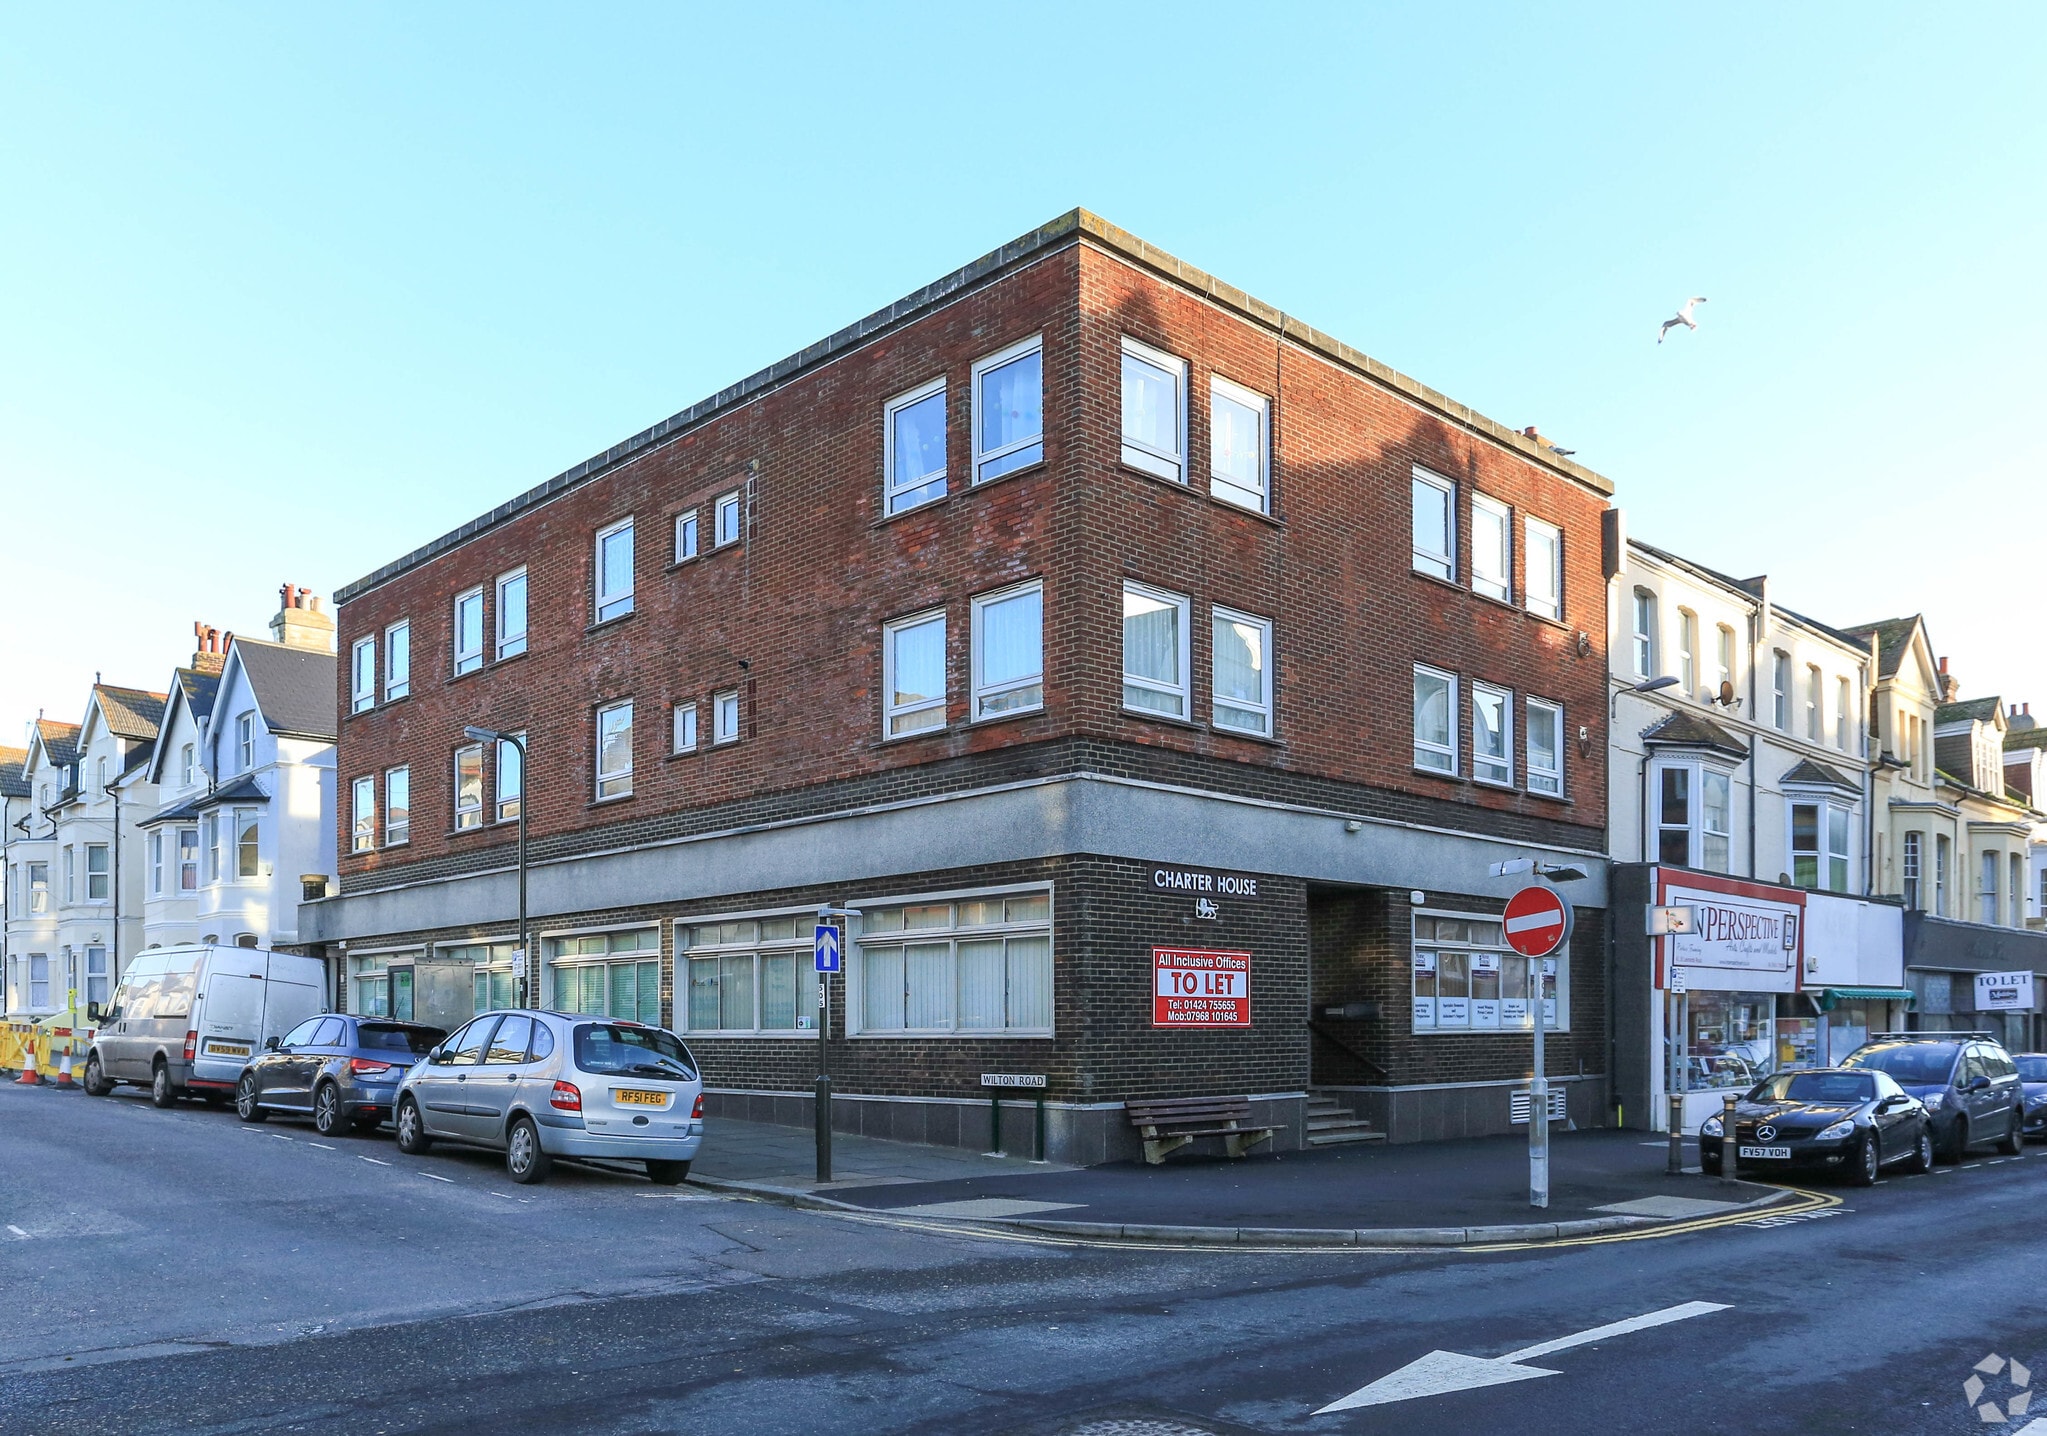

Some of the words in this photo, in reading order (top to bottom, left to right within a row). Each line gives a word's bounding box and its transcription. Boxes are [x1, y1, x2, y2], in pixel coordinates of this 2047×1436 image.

[1154, 869, 1213, 892] CHARTER
[1217, 876, 1257, 896] HOUSE
[1158, 954, 1171, 966] All
[1173, 954, 1214, 967] Inclusive
[1215, 957, 1246, 969] Offices
[1171, 972, 1198, 995] TO
[1205, 973, 1234, 995] LET
[1977, 976, 1997, 986] TO
[2001, 975, 2029, 985] LET
[1168, 999, 1182, 1010] Tel:
[1184, 1000, 1207, 1010] 01424
[1209, 1000, 1236, 1010] 755655
[1211, 1011, 1238, 1021] 101645
[983, 1075, 1015, 1085] WILTON
[1019, 1076, 1044, 1086] ROAD
[621, 1091, 643, 1103] RF51
[644, 1093, 662, 1104] FEG
[1743, 1147, 1766, 1156] FV57
